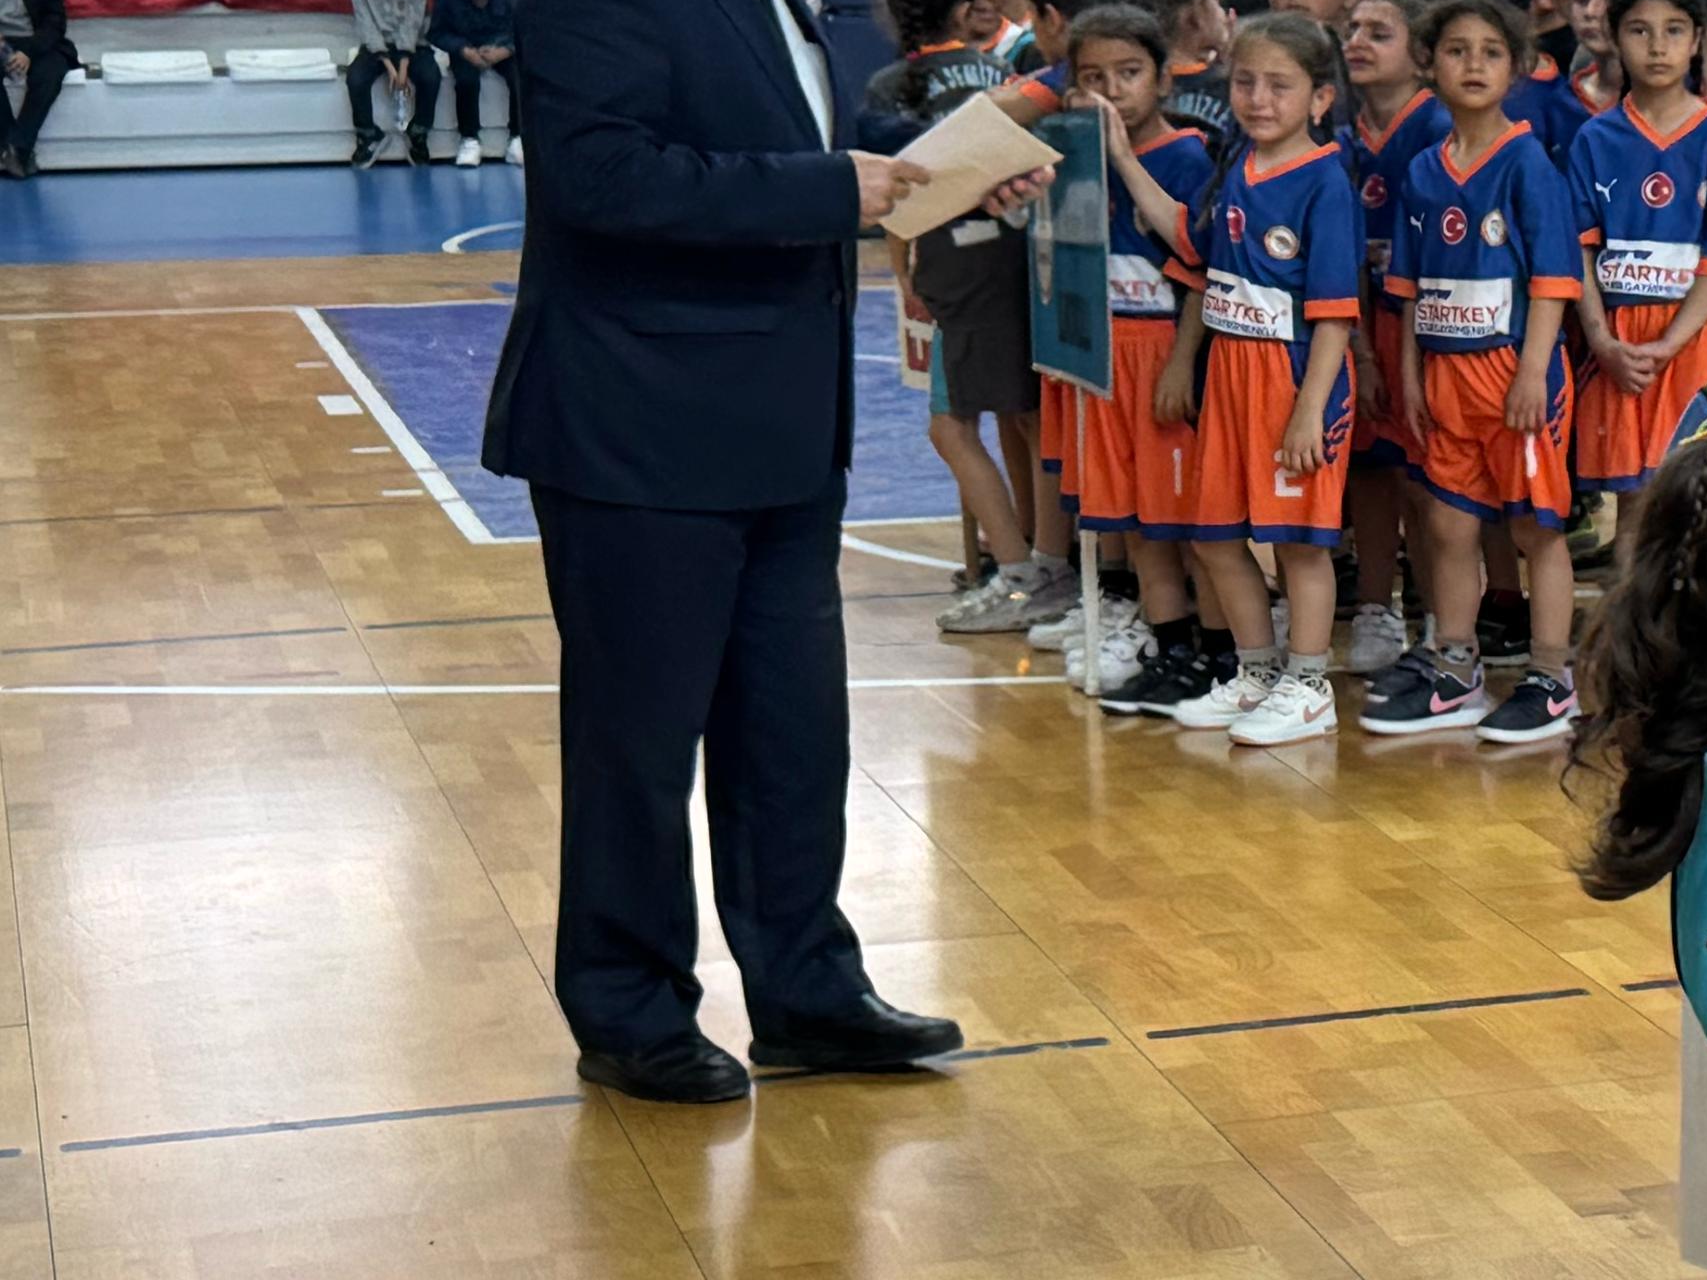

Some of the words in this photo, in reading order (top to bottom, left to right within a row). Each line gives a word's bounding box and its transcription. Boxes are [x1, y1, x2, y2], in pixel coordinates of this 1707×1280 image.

[1601, 262, 1692, 285] STARTKE
[1204, 295, 1279, 325] STARTKEY
[1417, 304, 1500, 322] STARTKEY
